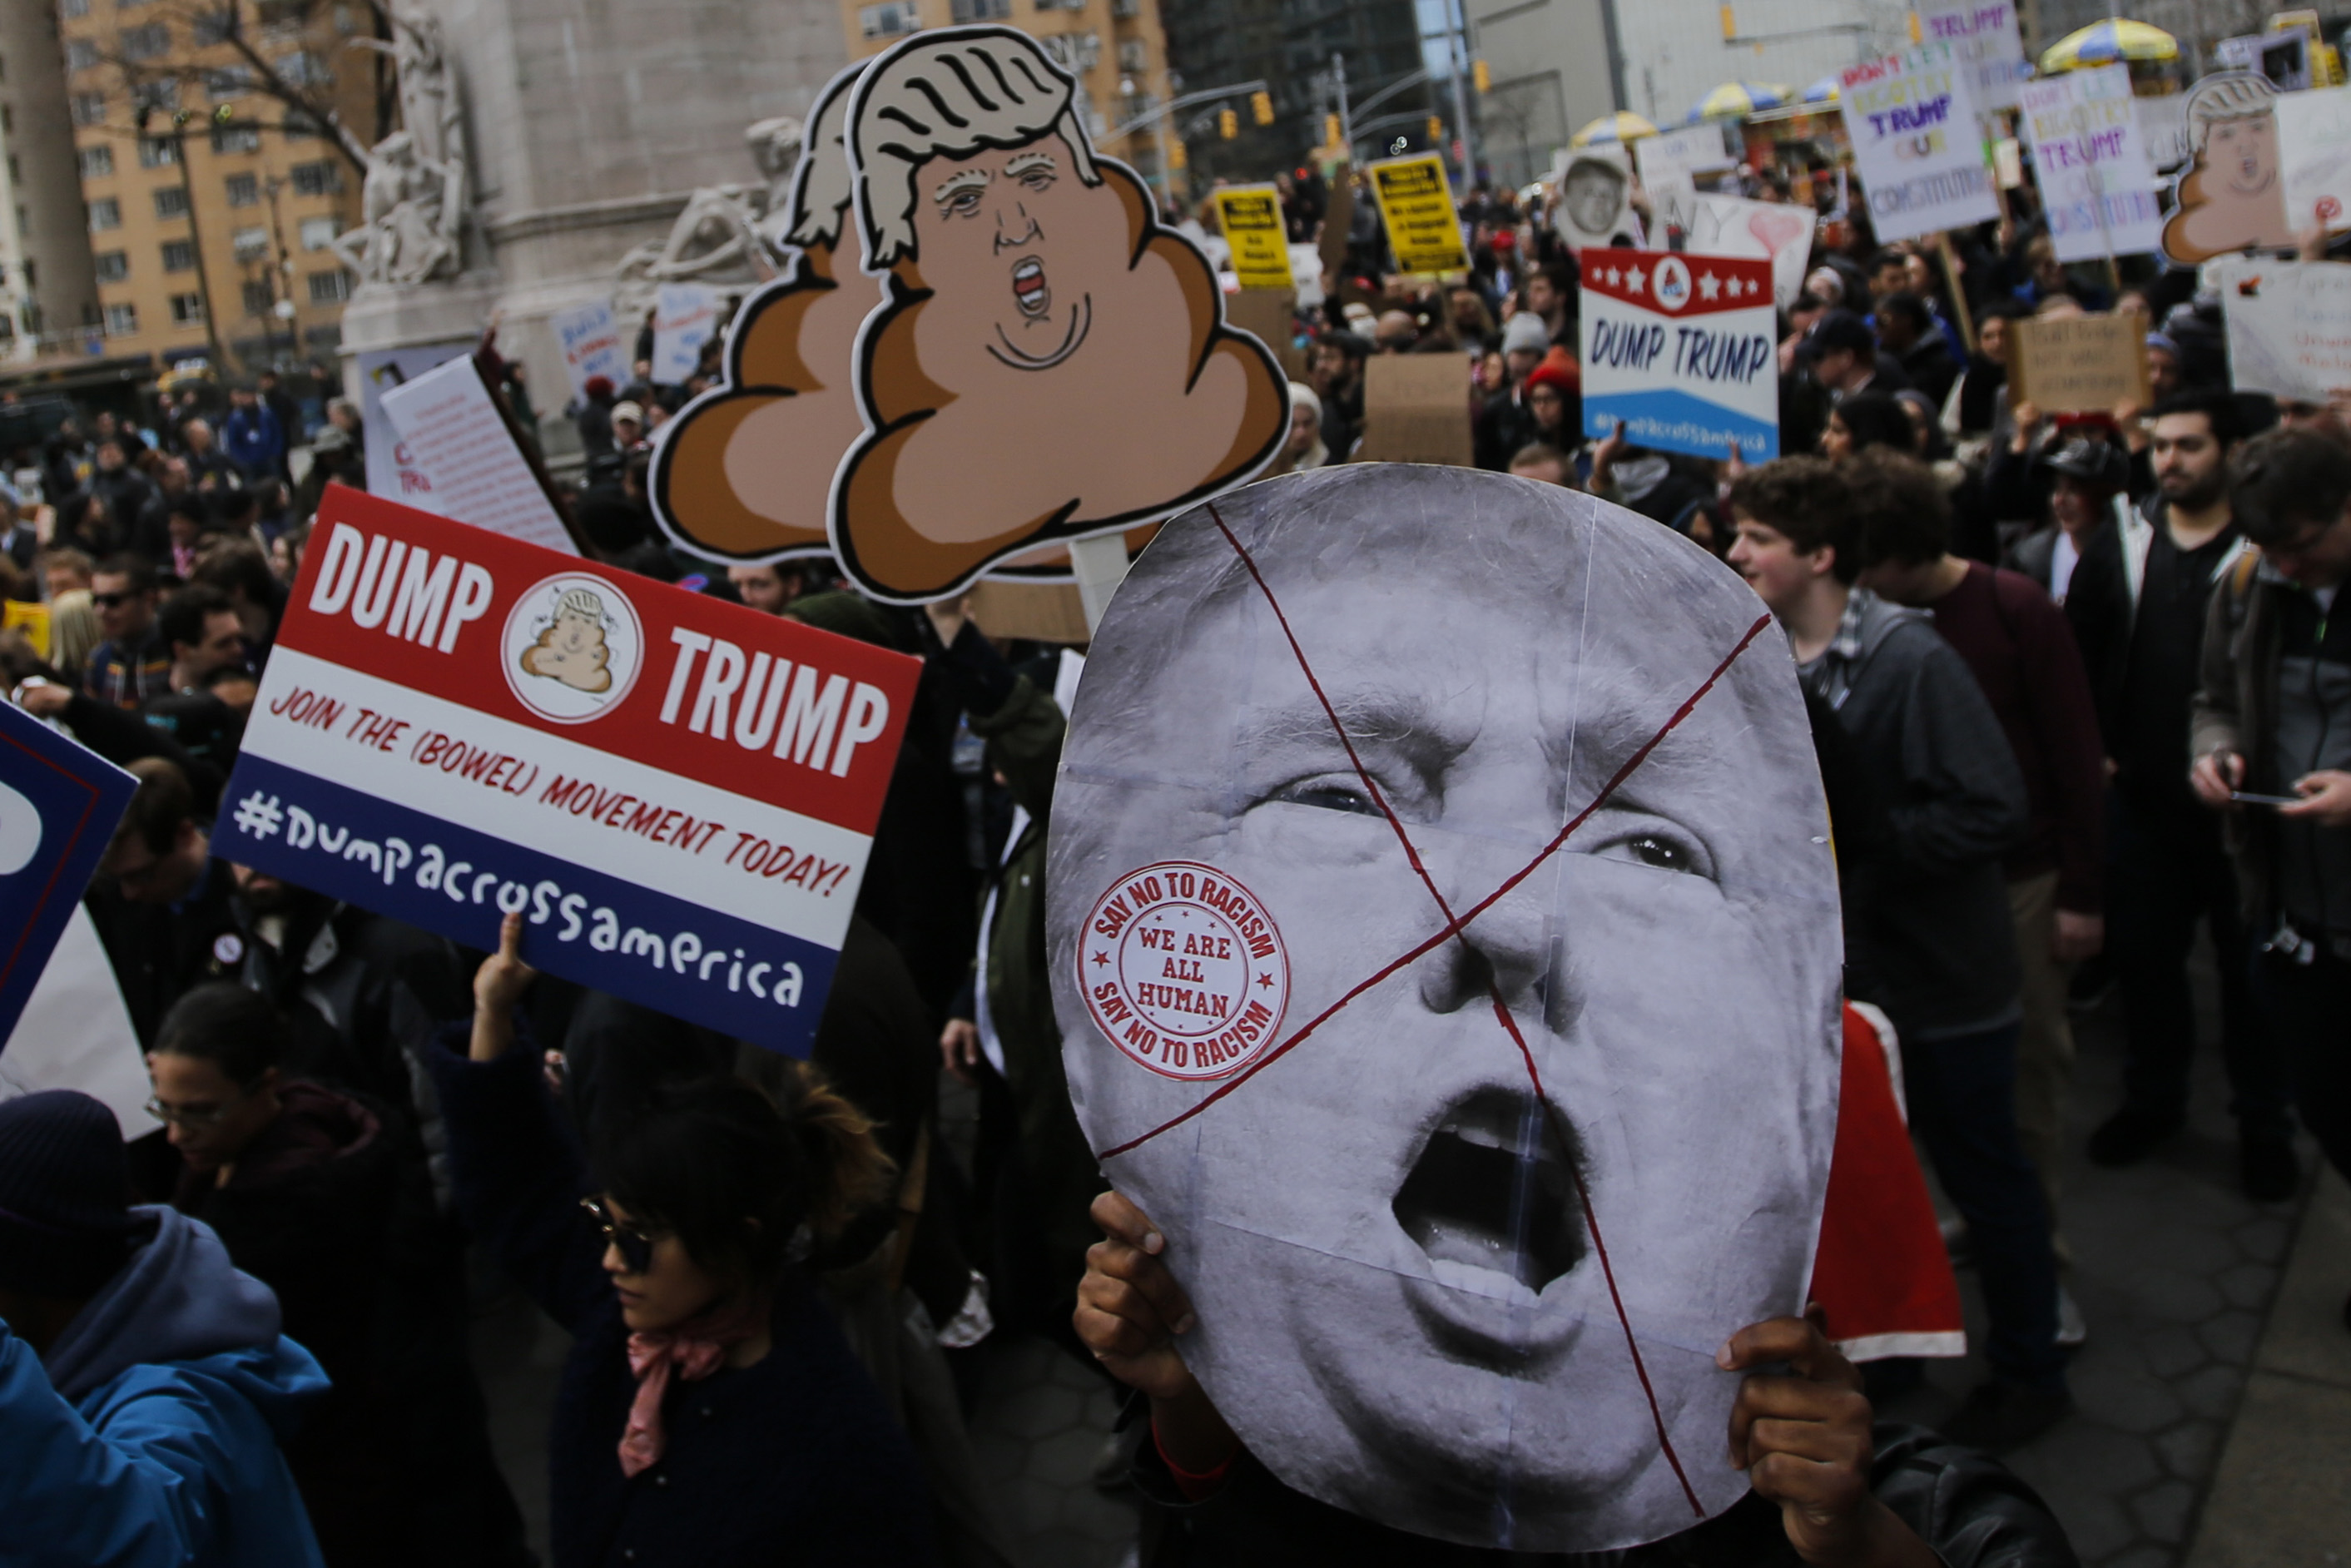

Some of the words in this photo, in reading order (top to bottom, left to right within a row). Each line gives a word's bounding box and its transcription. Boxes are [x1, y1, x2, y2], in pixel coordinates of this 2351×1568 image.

[1868, 93, 1952, 136] TRUMP
[2039, 127, 2126, 171] TRUMP
[1592, 320, 1664, 371] DUMP
[1675, 326, 1769, 385] TRUMP
[309, 521, 494, 654] DUMP
[659, 626, 889, 778] TRUMP
[270, 686, 345, 731] JOIN
[346, 708, 411, 752] THE
[410, 730, 538, 796] (BOWEL)
[538, 775, 727, 854] MOVEMENT
[725, 832, 850, 896] TODAY!
[1094, 894, 1133, 939] SAY
[1128, 876, 1163, 908] NO
[1164, 872, 1194, 898] TO
[1199, 876, 1276, 959] RACISM
[1138, 927, 1175, 951] WE
[1183, 933, 1231, 960] ARE
[1163, 957, 1204, 983] ALL
[1094, 981, 1133, 1025] SAY
[1123, 1019, 1158, 1054] NO
[1161, 1037, 1188, 1068] TO
[1193, 1000, 1272, 1068] RACISM
[1138, 982, 1228, 1018] HUMAN
